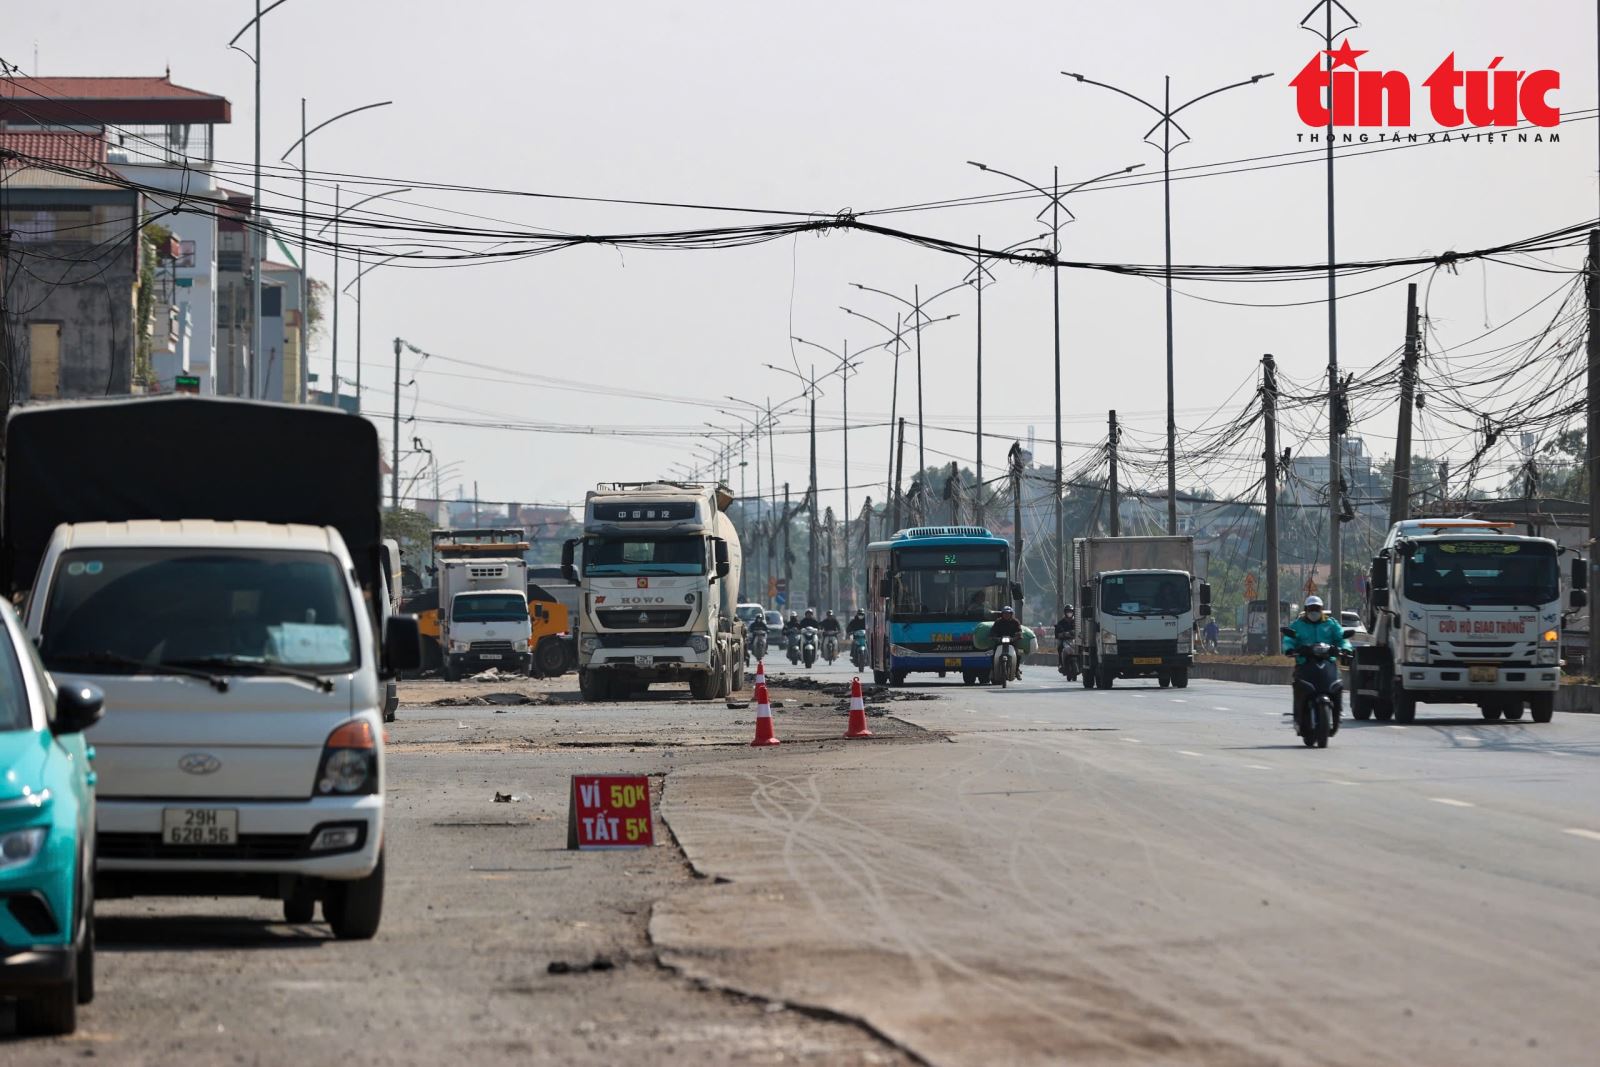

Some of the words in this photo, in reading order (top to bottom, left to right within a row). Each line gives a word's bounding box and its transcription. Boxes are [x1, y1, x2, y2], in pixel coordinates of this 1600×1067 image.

[1474, 620, 1494, 634] GIAO
[580, 779, 601, 808] VÍ
[610, 784, 645, 808] 50K
[185, 809, 217, 826] 29H
[582, 809, 619, 841] TẤT
[625, 818, 648, 841] 5K
